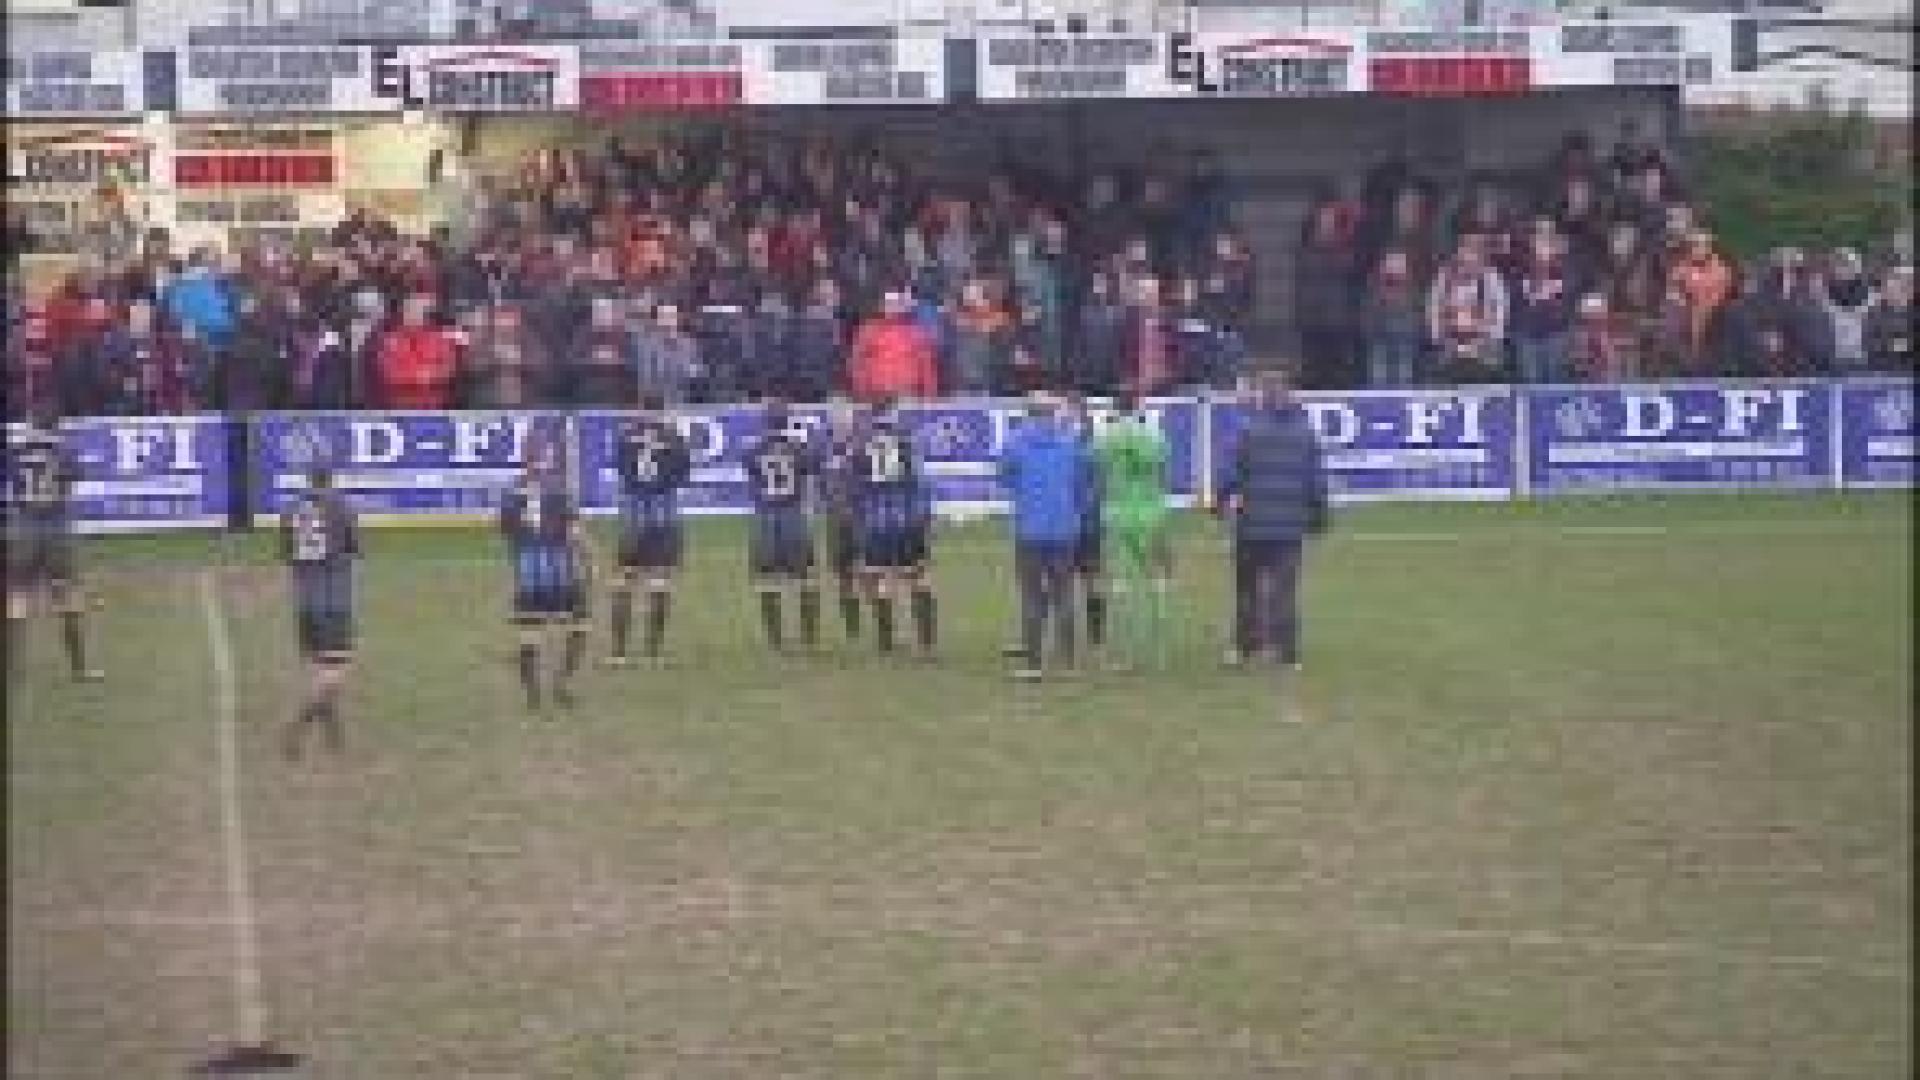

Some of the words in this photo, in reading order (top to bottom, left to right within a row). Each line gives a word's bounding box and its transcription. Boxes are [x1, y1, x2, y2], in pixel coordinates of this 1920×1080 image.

[372, 48, 424, 106] EL
[1167, 36, 1220, 92] EL
[1308, 400, 1487, 444] D-FI
[1622, 388, 1804, 438] D-FI
